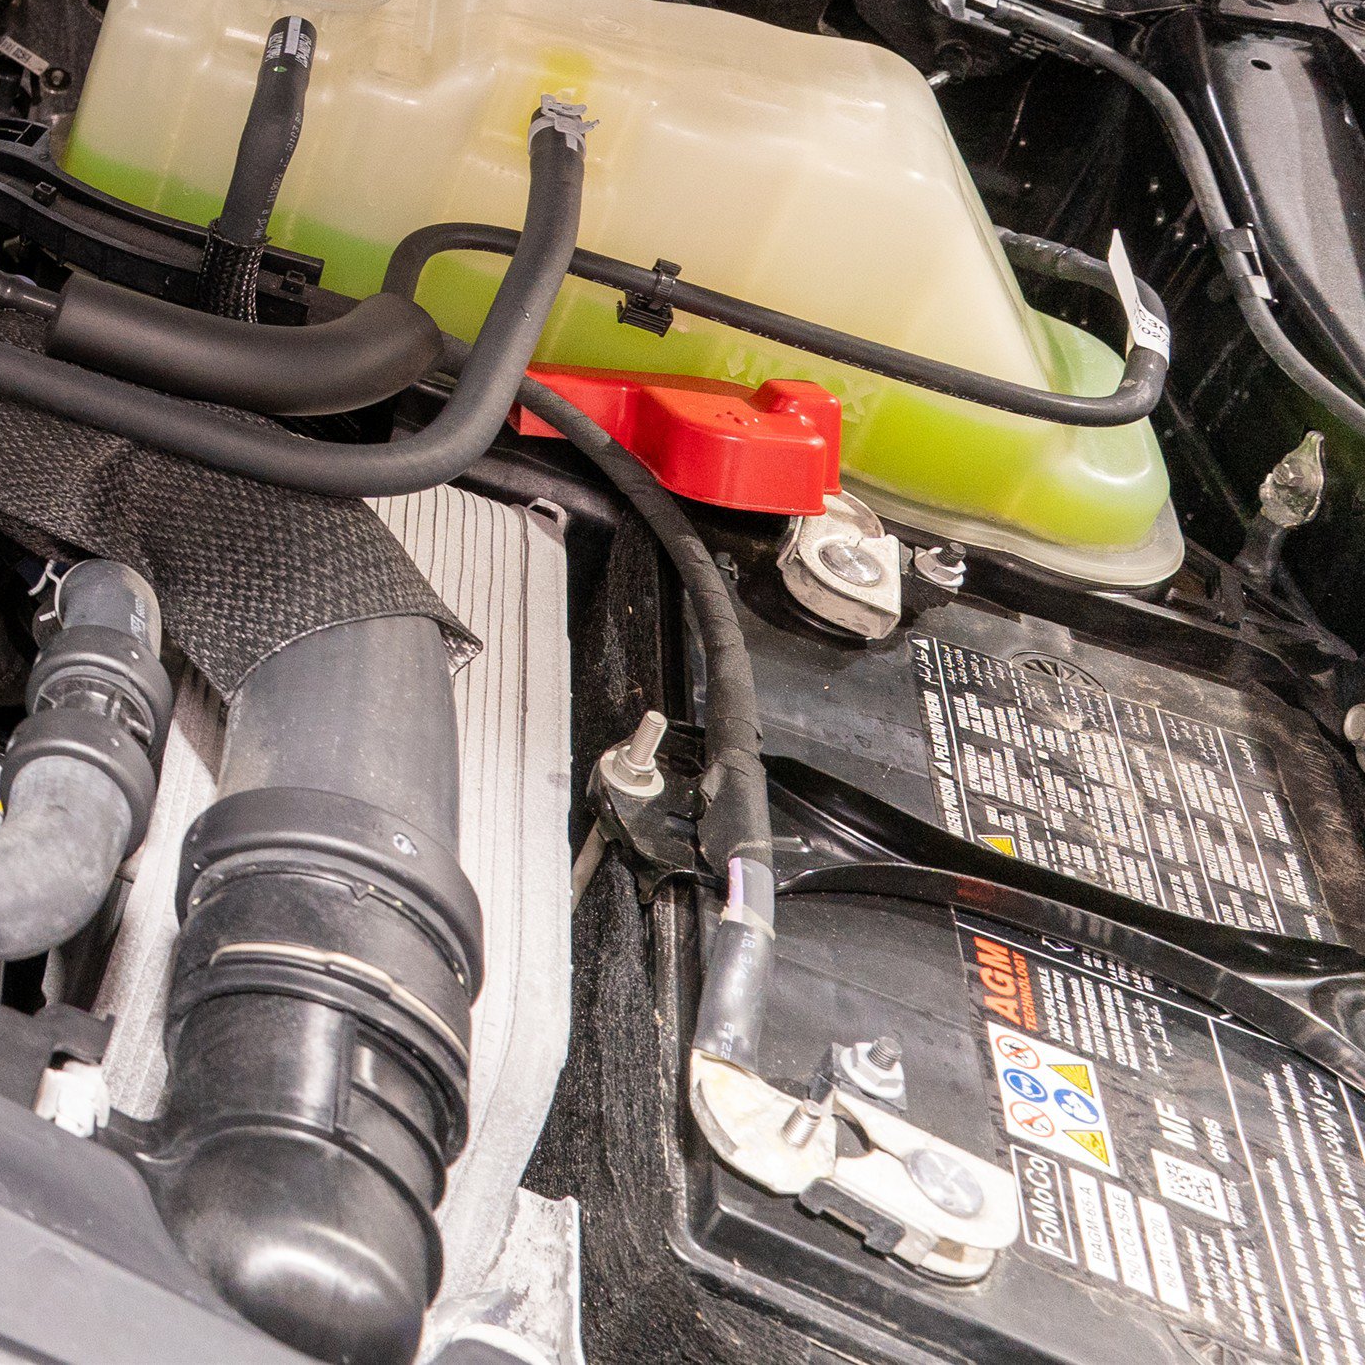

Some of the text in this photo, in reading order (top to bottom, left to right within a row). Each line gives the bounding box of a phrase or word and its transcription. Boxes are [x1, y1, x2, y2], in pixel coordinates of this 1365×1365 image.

[970, 931, 1023, 1027] AGM
[1010, 948, 1040, 1034] TECHNOLOGY
[1035, 964, 1063, 1042] NON-SPILLABLE
[1048, 966, 1076, 1047] Lead Acid Battery
[1093, 1036, 1109, 1059] ANTI
[1098, 980, 1128, 1066] CONTRA DERRAMES
[1153, 1096, 1198, 1152] MF
[1018, 1149, 1069, 1257] FoMoCo
[1077, 1181, 1107, 1264] BAGM-65-A
[1110, 1189, 1139, 1258] CCA/SAE
[1148, 1215, 1169, 1248] C20
